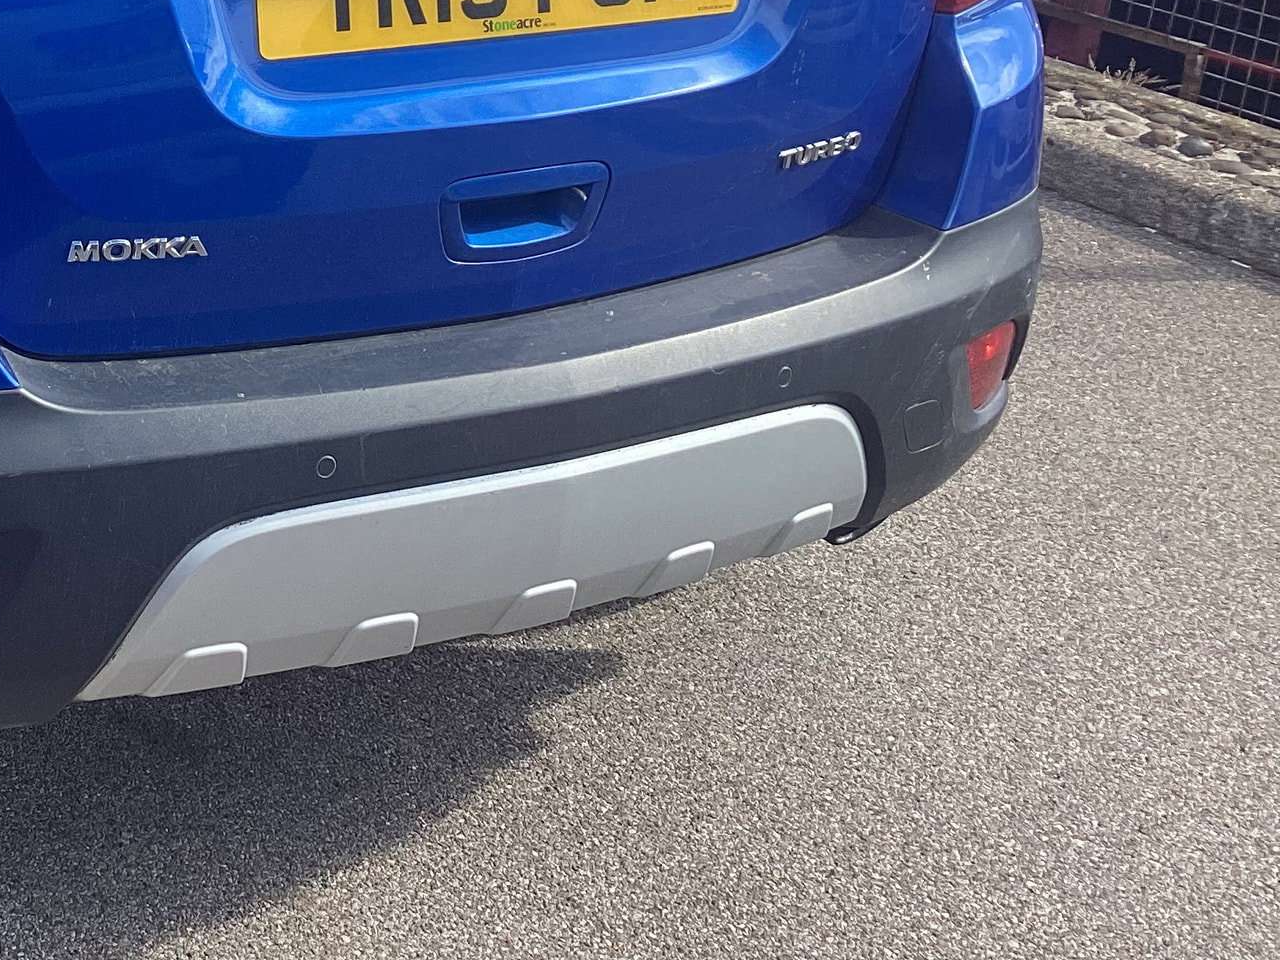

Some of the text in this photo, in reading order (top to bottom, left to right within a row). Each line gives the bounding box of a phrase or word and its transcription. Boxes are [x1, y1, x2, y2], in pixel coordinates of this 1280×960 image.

[482, 17, 542, 33] Stoneacre
[778, 130, 862, 168] TURBO
[66, 235, 209, 262] MOKKA
